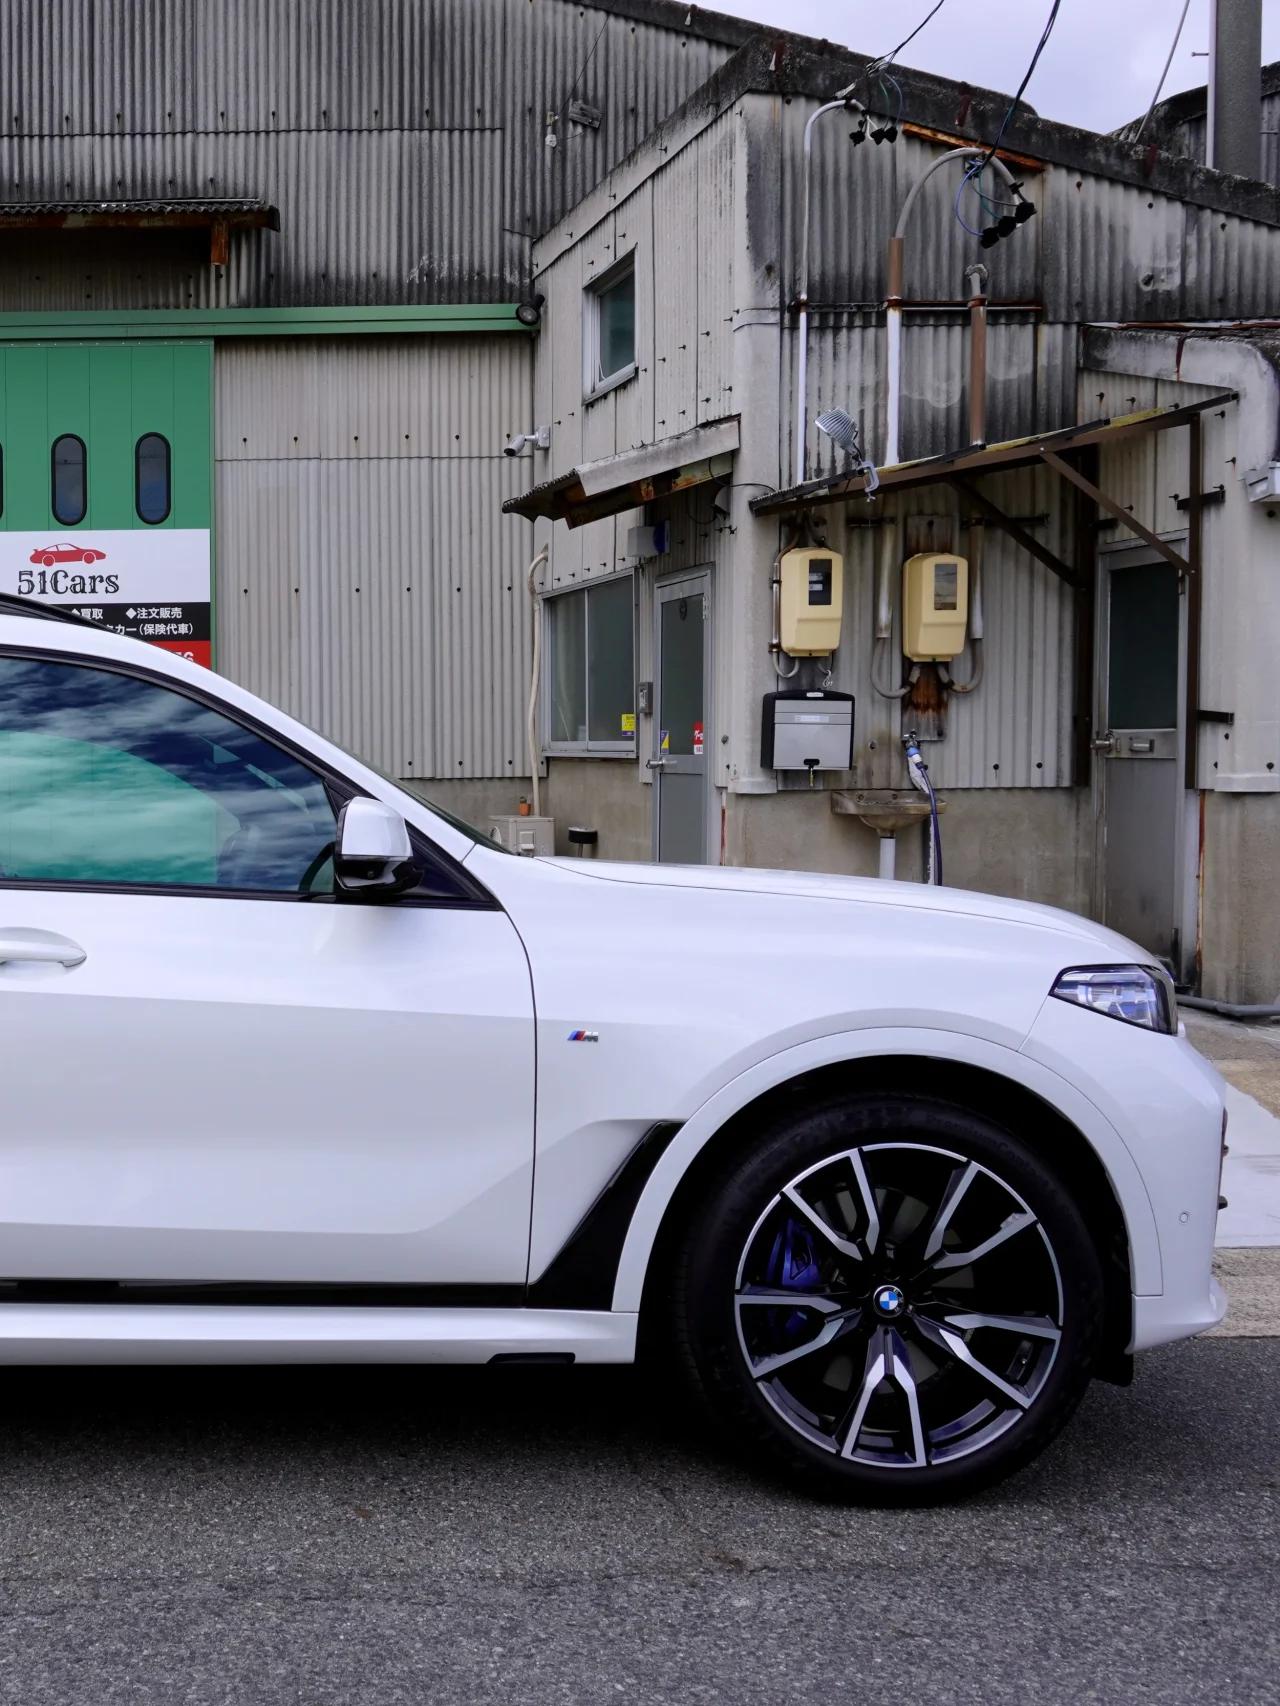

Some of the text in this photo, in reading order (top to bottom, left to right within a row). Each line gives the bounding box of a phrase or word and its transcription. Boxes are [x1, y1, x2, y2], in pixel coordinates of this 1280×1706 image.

[18, 570, 120, 595] 51Cars
[80, 608, 182, 620] 買取 注文販売
